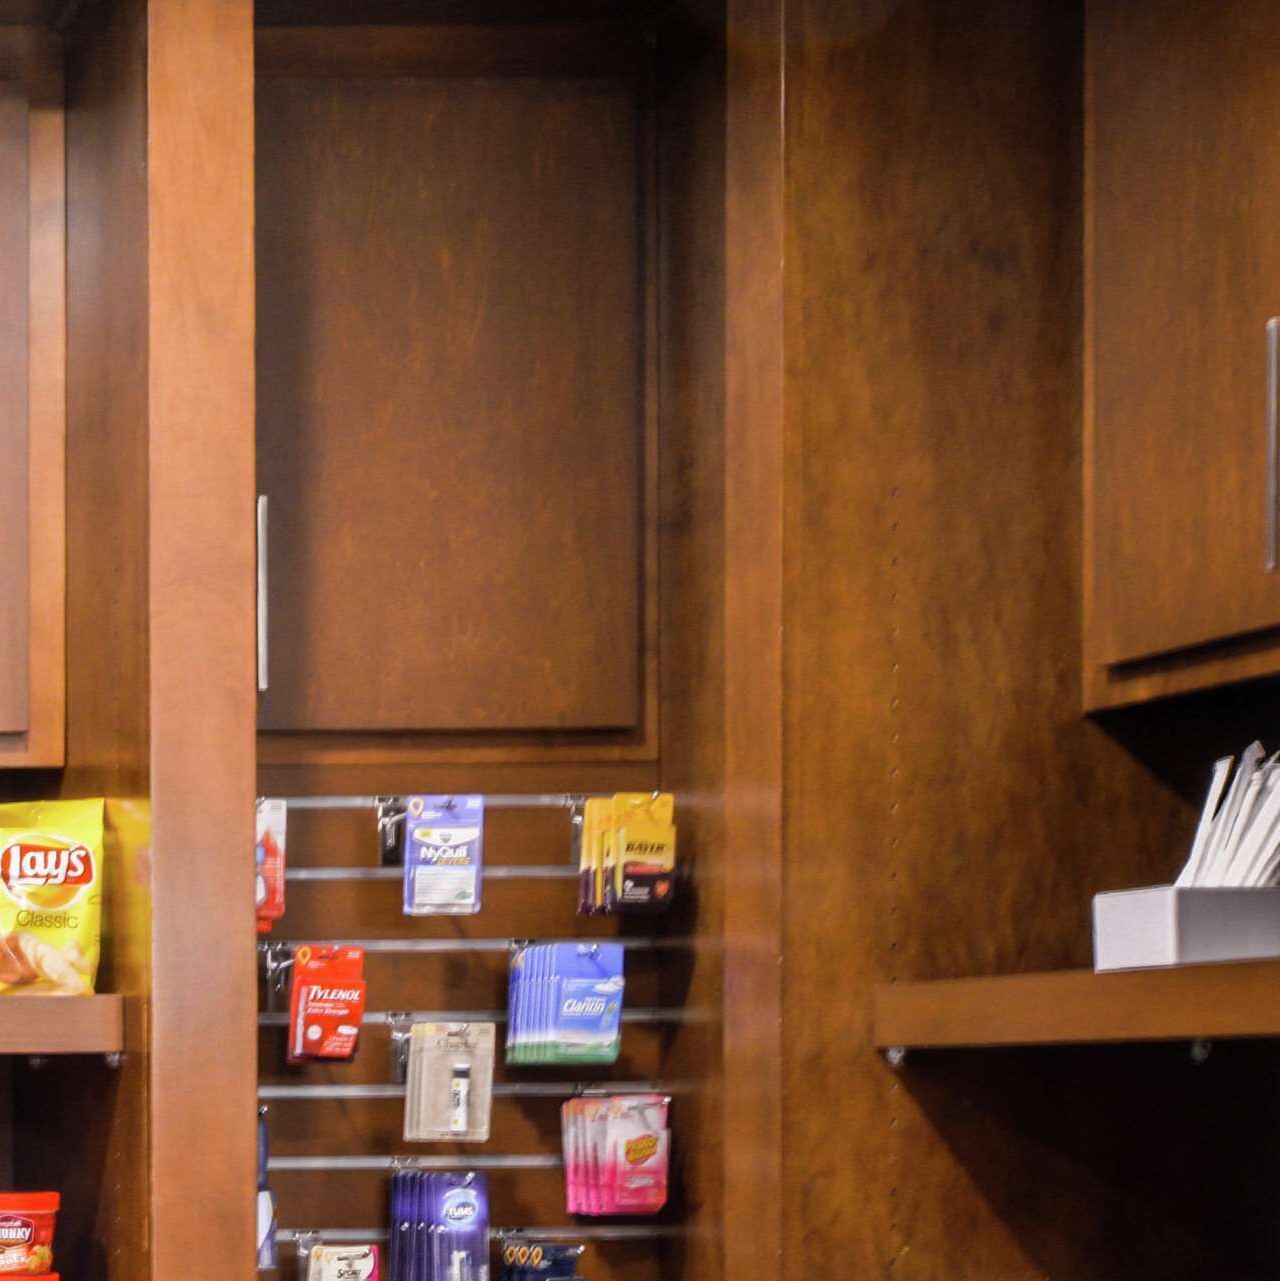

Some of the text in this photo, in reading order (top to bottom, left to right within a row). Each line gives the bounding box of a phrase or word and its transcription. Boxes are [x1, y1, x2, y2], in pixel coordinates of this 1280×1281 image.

[420, 846, 467, 862] NyQuil
[8, 846, 86, 886] Lay's
[16, 910, 79, 929] Classic
[308, 985, 360, 1001] TYLENOL
